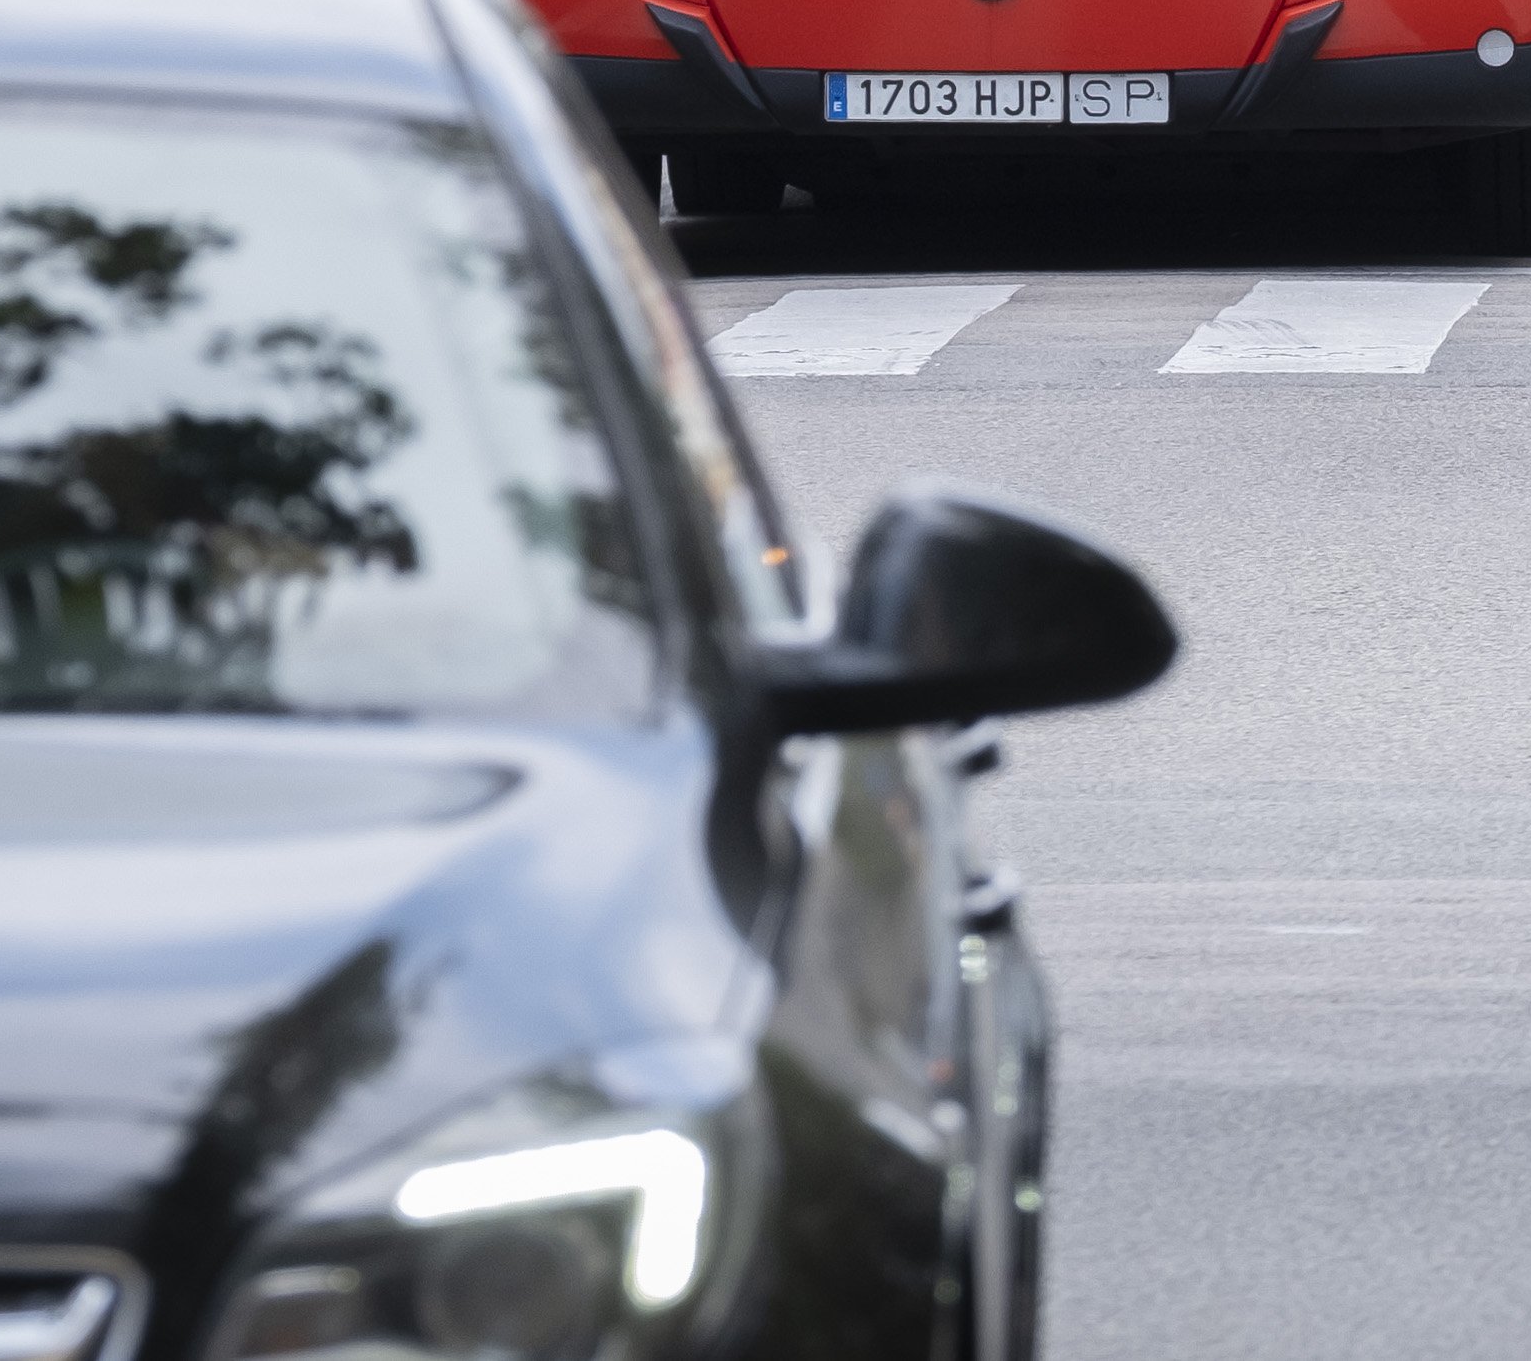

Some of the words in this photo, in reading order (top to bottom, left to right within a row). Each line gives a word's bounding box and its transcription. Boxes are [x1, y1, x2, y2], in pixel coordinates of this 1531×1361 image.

[833, 100, 843, 113] E
[860, 79, 958, 116] 1703
[974, 79, 1052, 117] HJP
